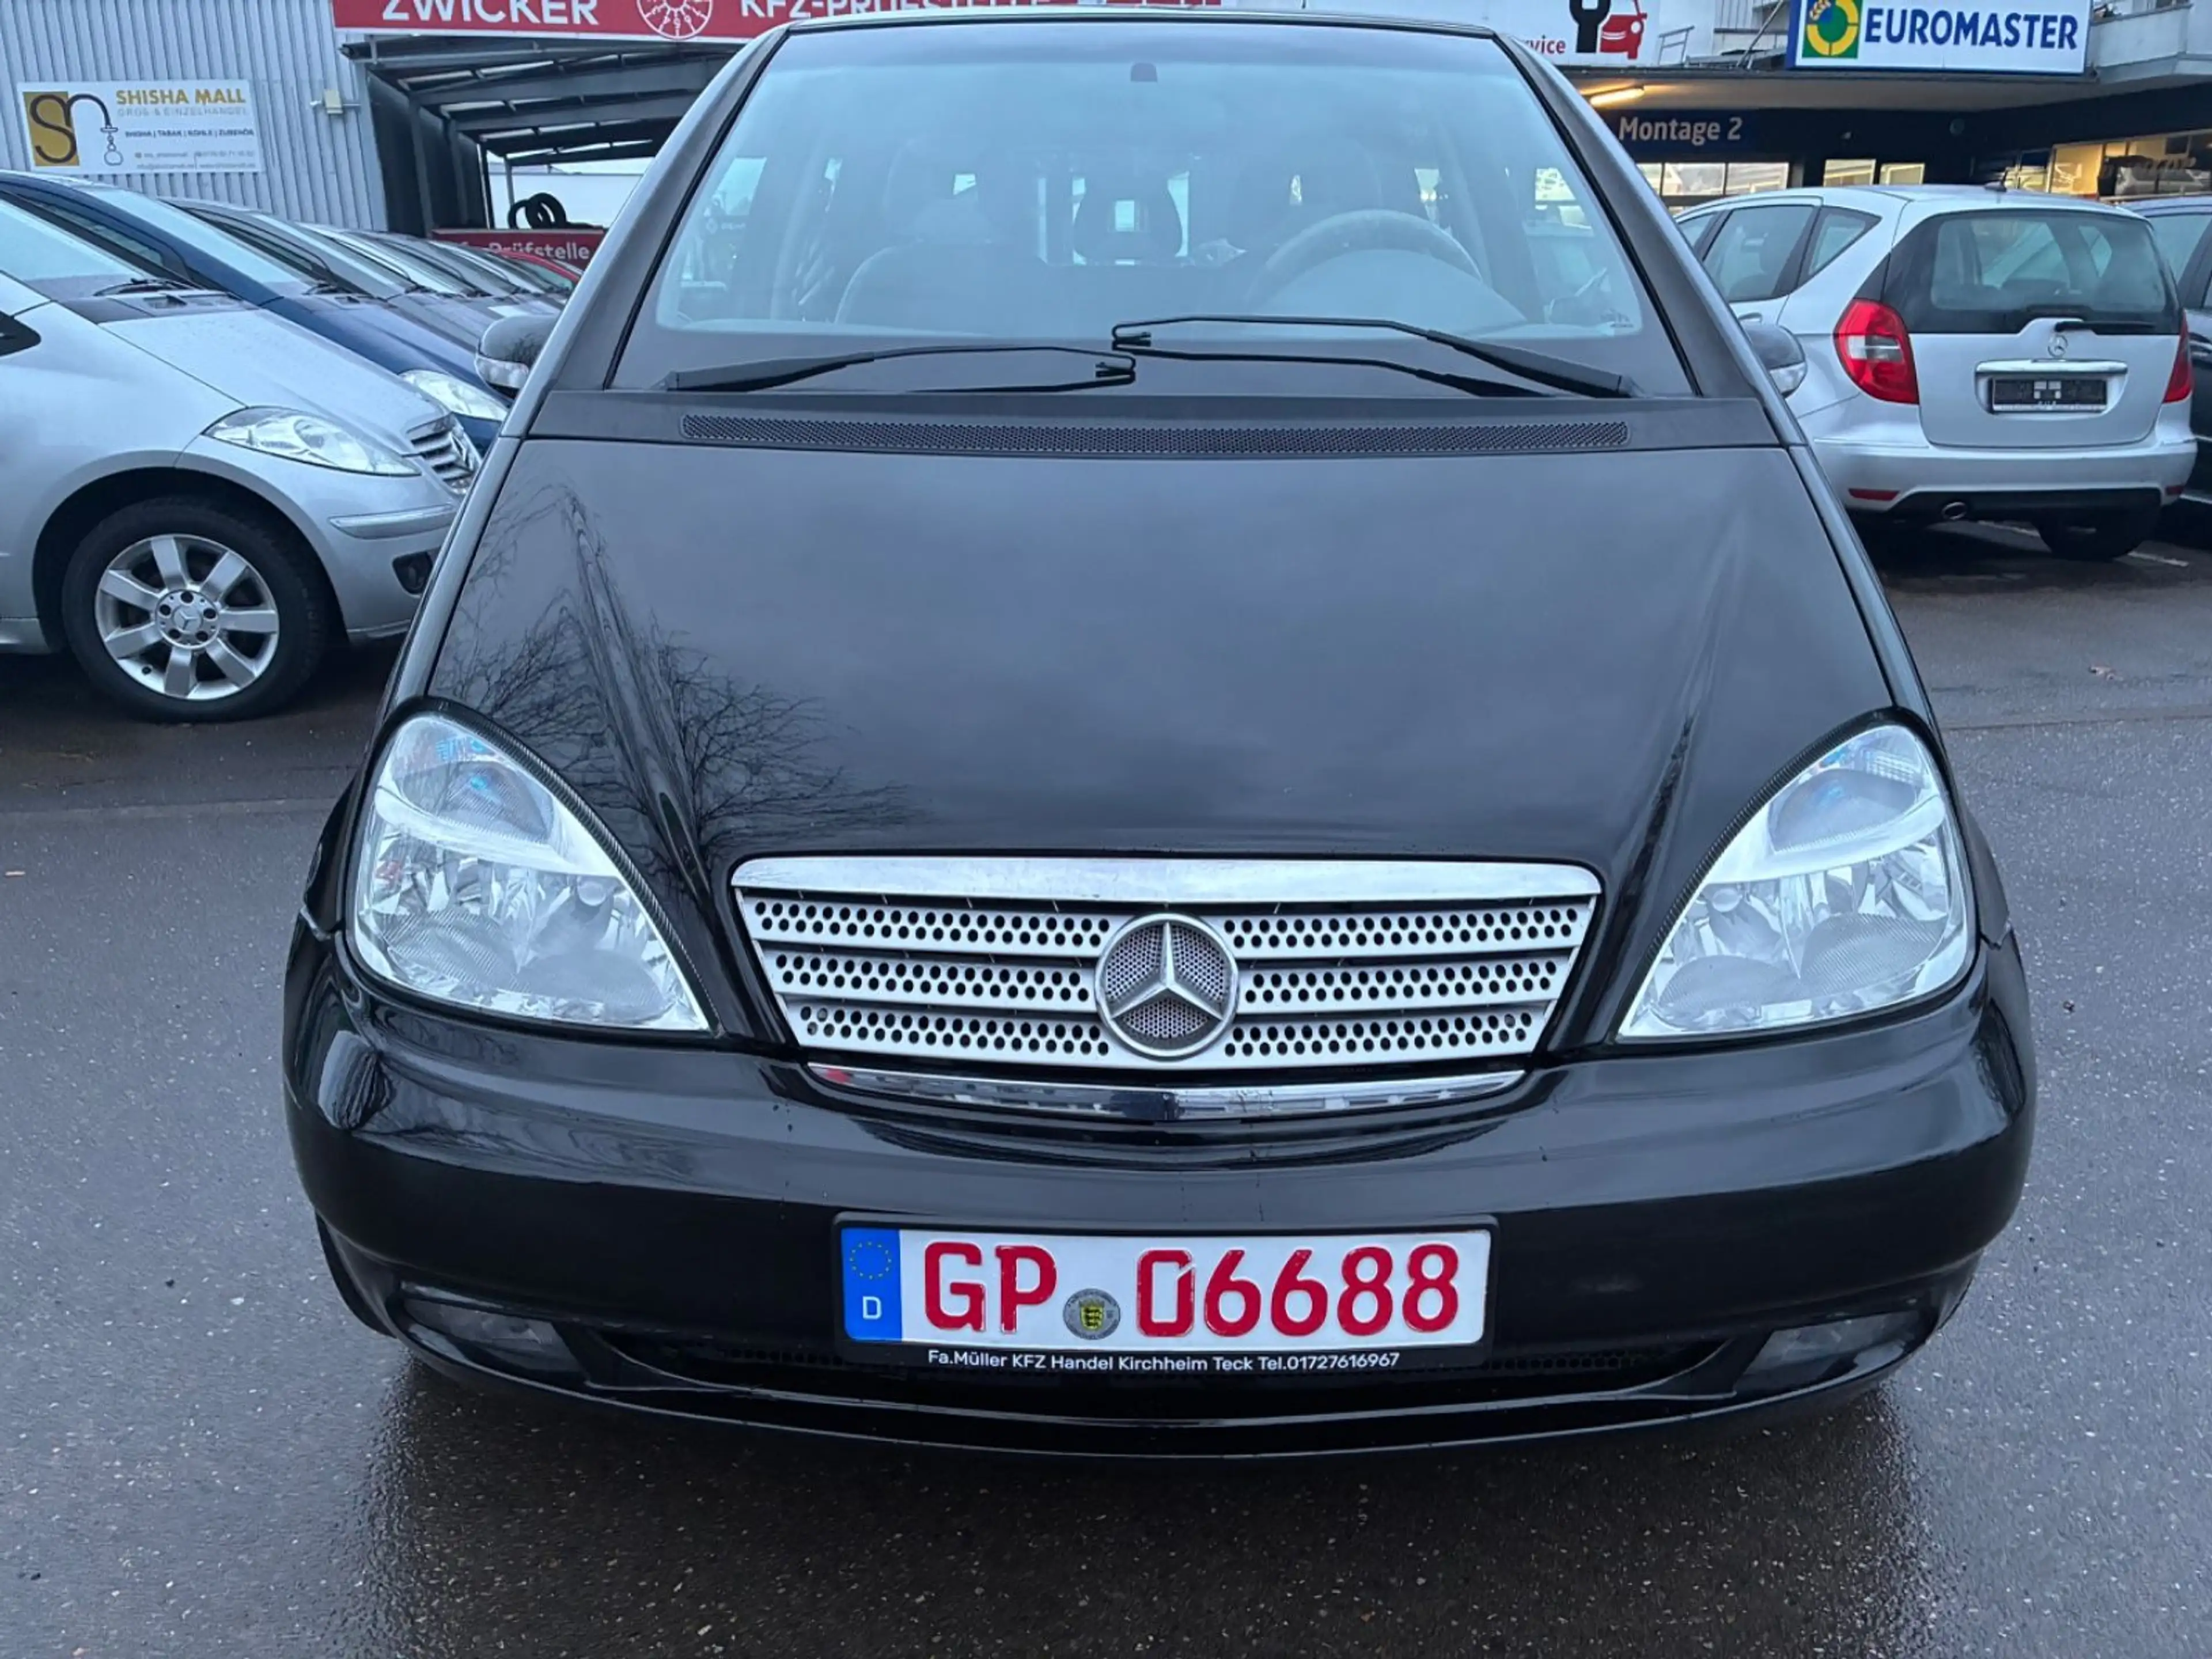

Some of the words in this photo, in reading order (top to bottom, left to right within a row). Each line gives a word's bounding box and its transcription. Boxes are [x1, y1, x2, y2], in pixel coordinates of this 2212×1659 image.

[382, 0, 599, 25] ZWICKER
[1864, 7, 2078, 50] EUROMASTER
[116, 89, 189, 105] SHISHA
[195, 88, 247, 105] MALL
[1619, 116, 1721, 146] Montage
[1727, 116, 1743, 140] 2
[925, 1242, 1057, 1335] GP
[1137, 1243, 1459, 1338] 06688
[862, 1296, 882, 1320] D
[928, 1350, 1007, 1367] Fa.Müller
[1012, 1354, 1047, 1369] KFZ
[1051, 1355, 1113, 1370] Handel
[1119, 1356, 1208, 1370] Kirchheim
[1213, 1356, 1253, 1371] Teck
